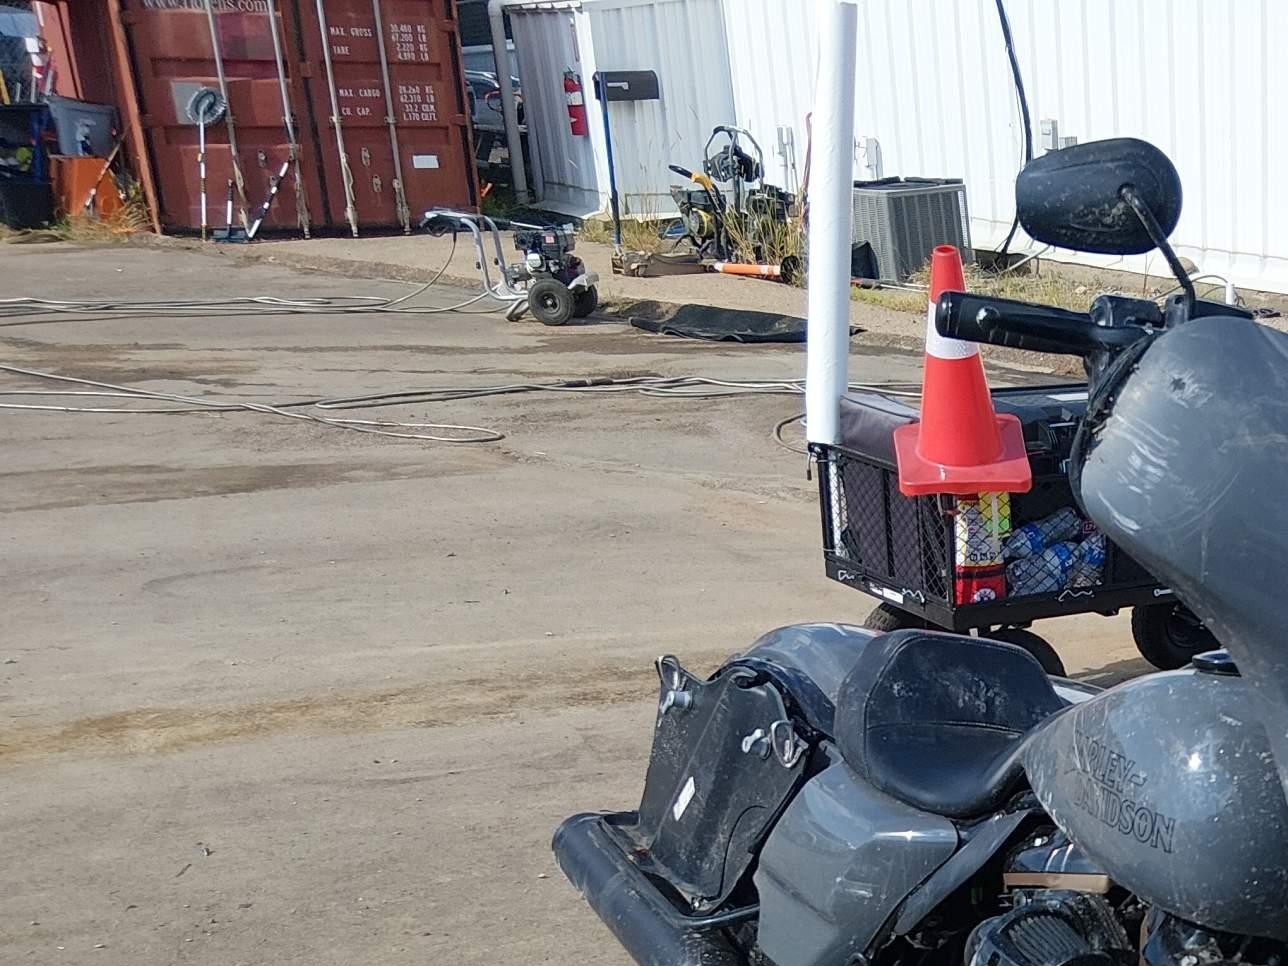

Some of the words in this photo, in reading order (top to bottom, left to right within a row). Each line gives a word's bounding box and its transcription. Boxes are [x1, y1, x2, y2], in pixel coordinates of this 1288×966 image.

[417, 25, 425, 33] KG
[418, 33, 427, 42] LB
[333, 45, 350, 55] TARE
[419, 43, 428, 52] KG
[420, 52, 429, 61] LB
[359, 88, 381, 97] CARGO
[424, 85, 434, 94] KG
[426, 94, 435, 103] LB
